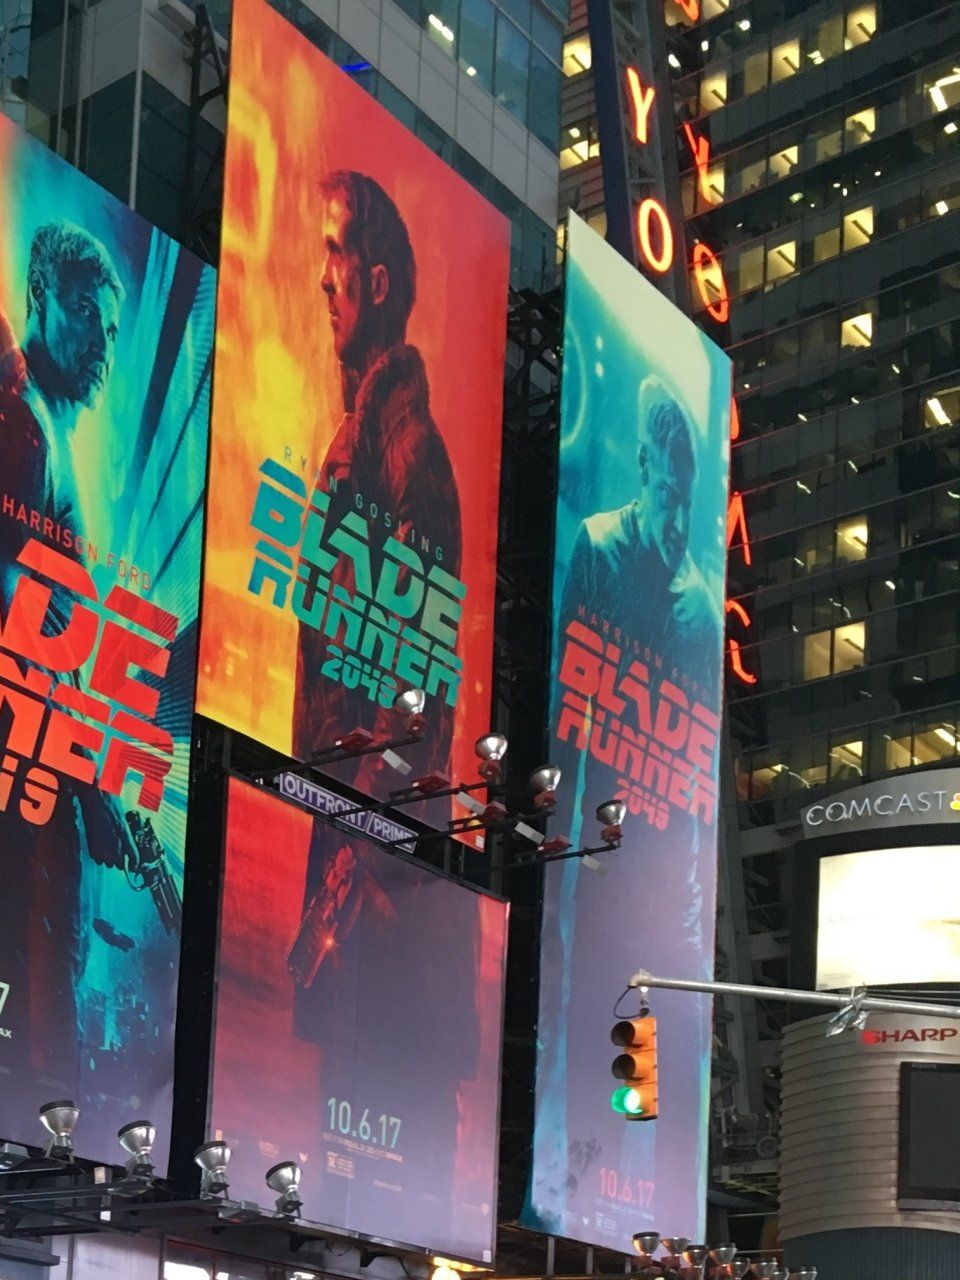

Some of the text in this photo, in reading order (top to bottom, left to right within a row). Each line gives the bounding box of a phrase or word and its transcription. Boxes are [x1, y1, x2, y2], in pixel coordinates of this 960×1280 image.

[284, 445, 443, 561] RYAN GOSLING
[2, 493, 152, 591] HARRISON FORD
[249, 457, 467, 649] BLADE
[247, 539, 464, 708] RUNNER
[578, 604, 663, 670] HARRISON
[321, 645, 398, 708] 2049
[558, 619, 721, 774] BLADE
[556, 691, 717, 827] RUNNER
[284, 776, 413, 849] OUTFRONT PRIME
[613, 777, 670, 831] 2049
[806, 790, 948, 826] COMCAST
[861, 1028, 958, 1045] SHARP
[327, 1097, 402, 1149] 10.6.17
[600, 1166, 655, 1209] 10.6.17
